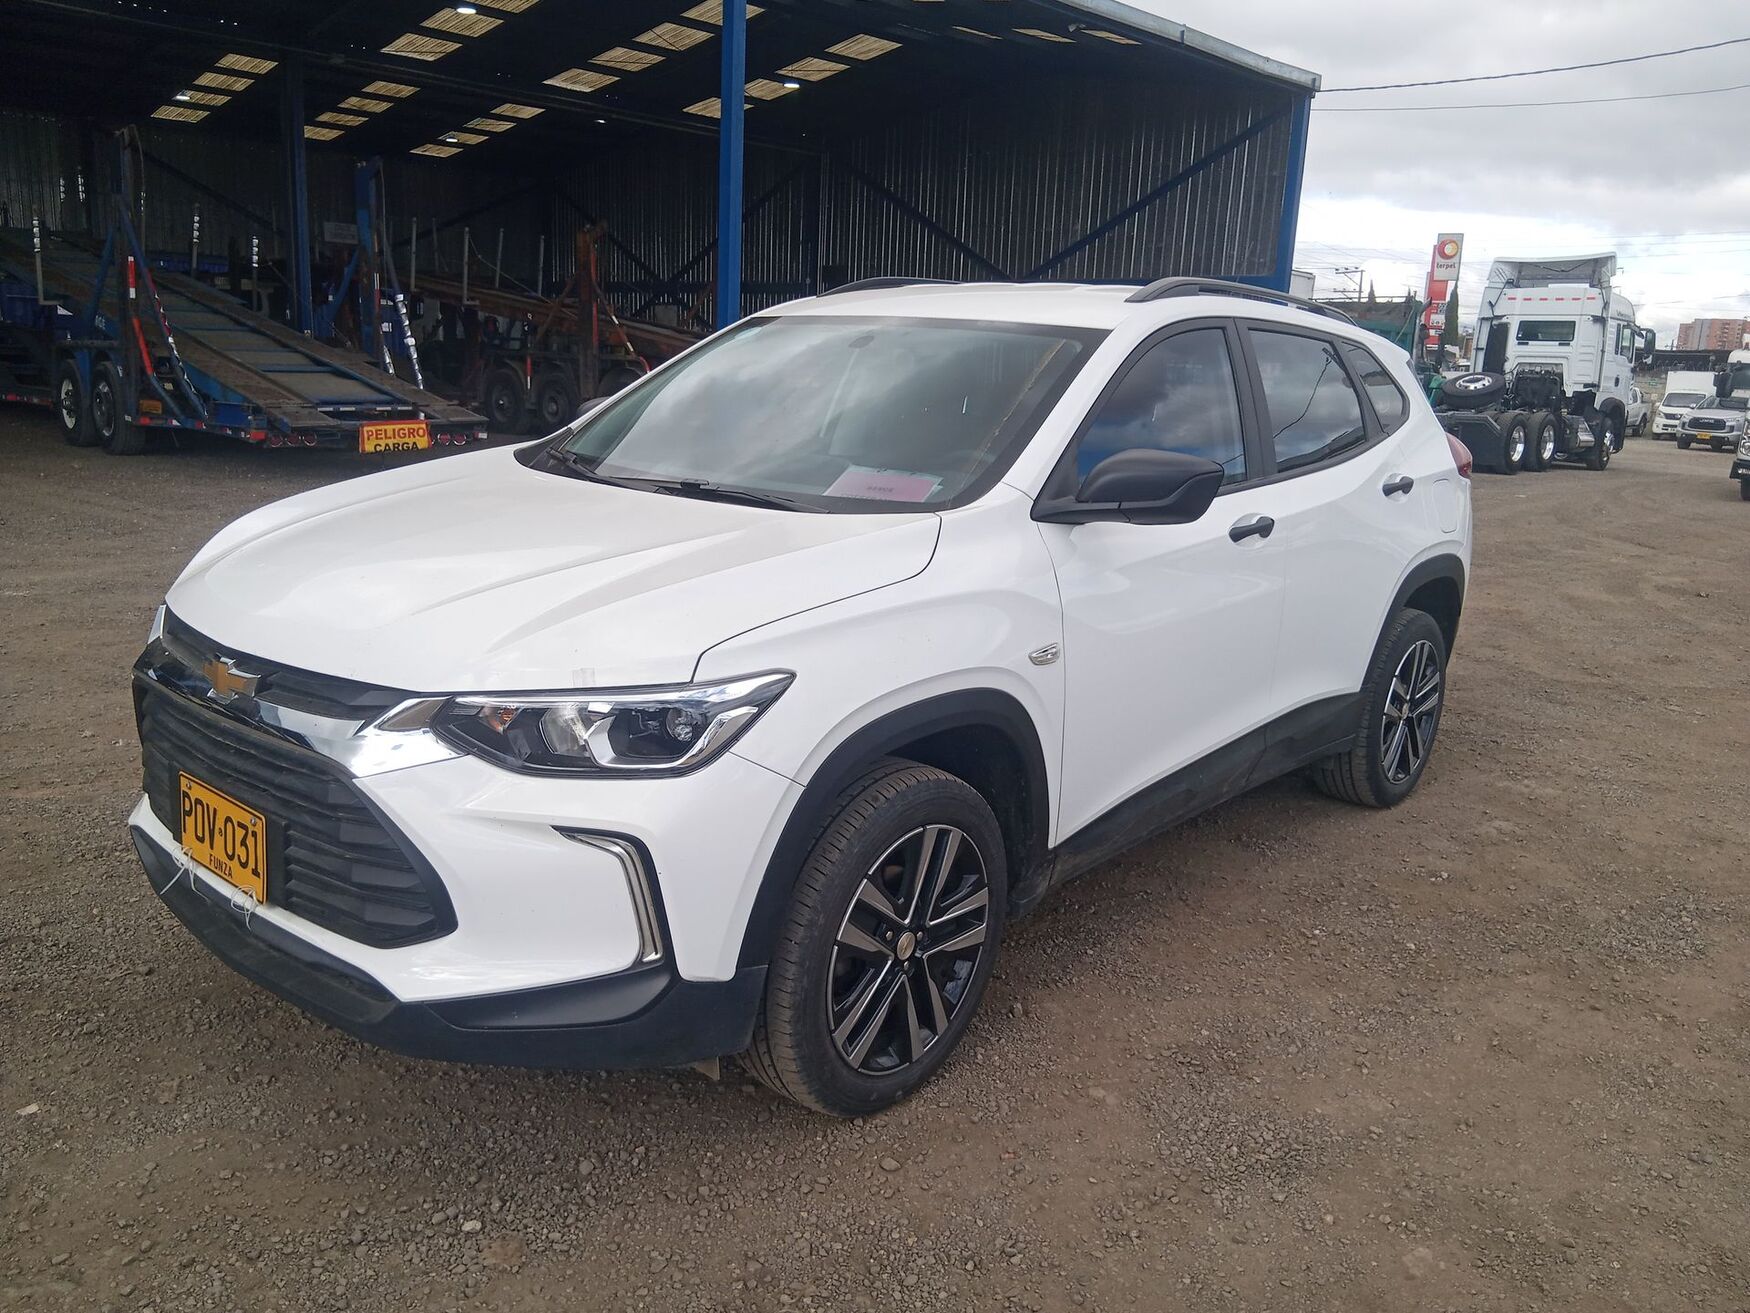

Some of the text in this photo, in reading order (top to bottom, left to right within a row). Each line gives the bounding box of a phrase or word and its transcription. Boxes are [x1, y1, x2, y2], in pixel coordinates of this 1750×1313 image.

[1436, 261, 1456, 270] terpel
[366, 427, 426, 440] PELIGRO
[373, 442, 419, 453] CARGA
[209, 854, 233, 879] FUNZA
